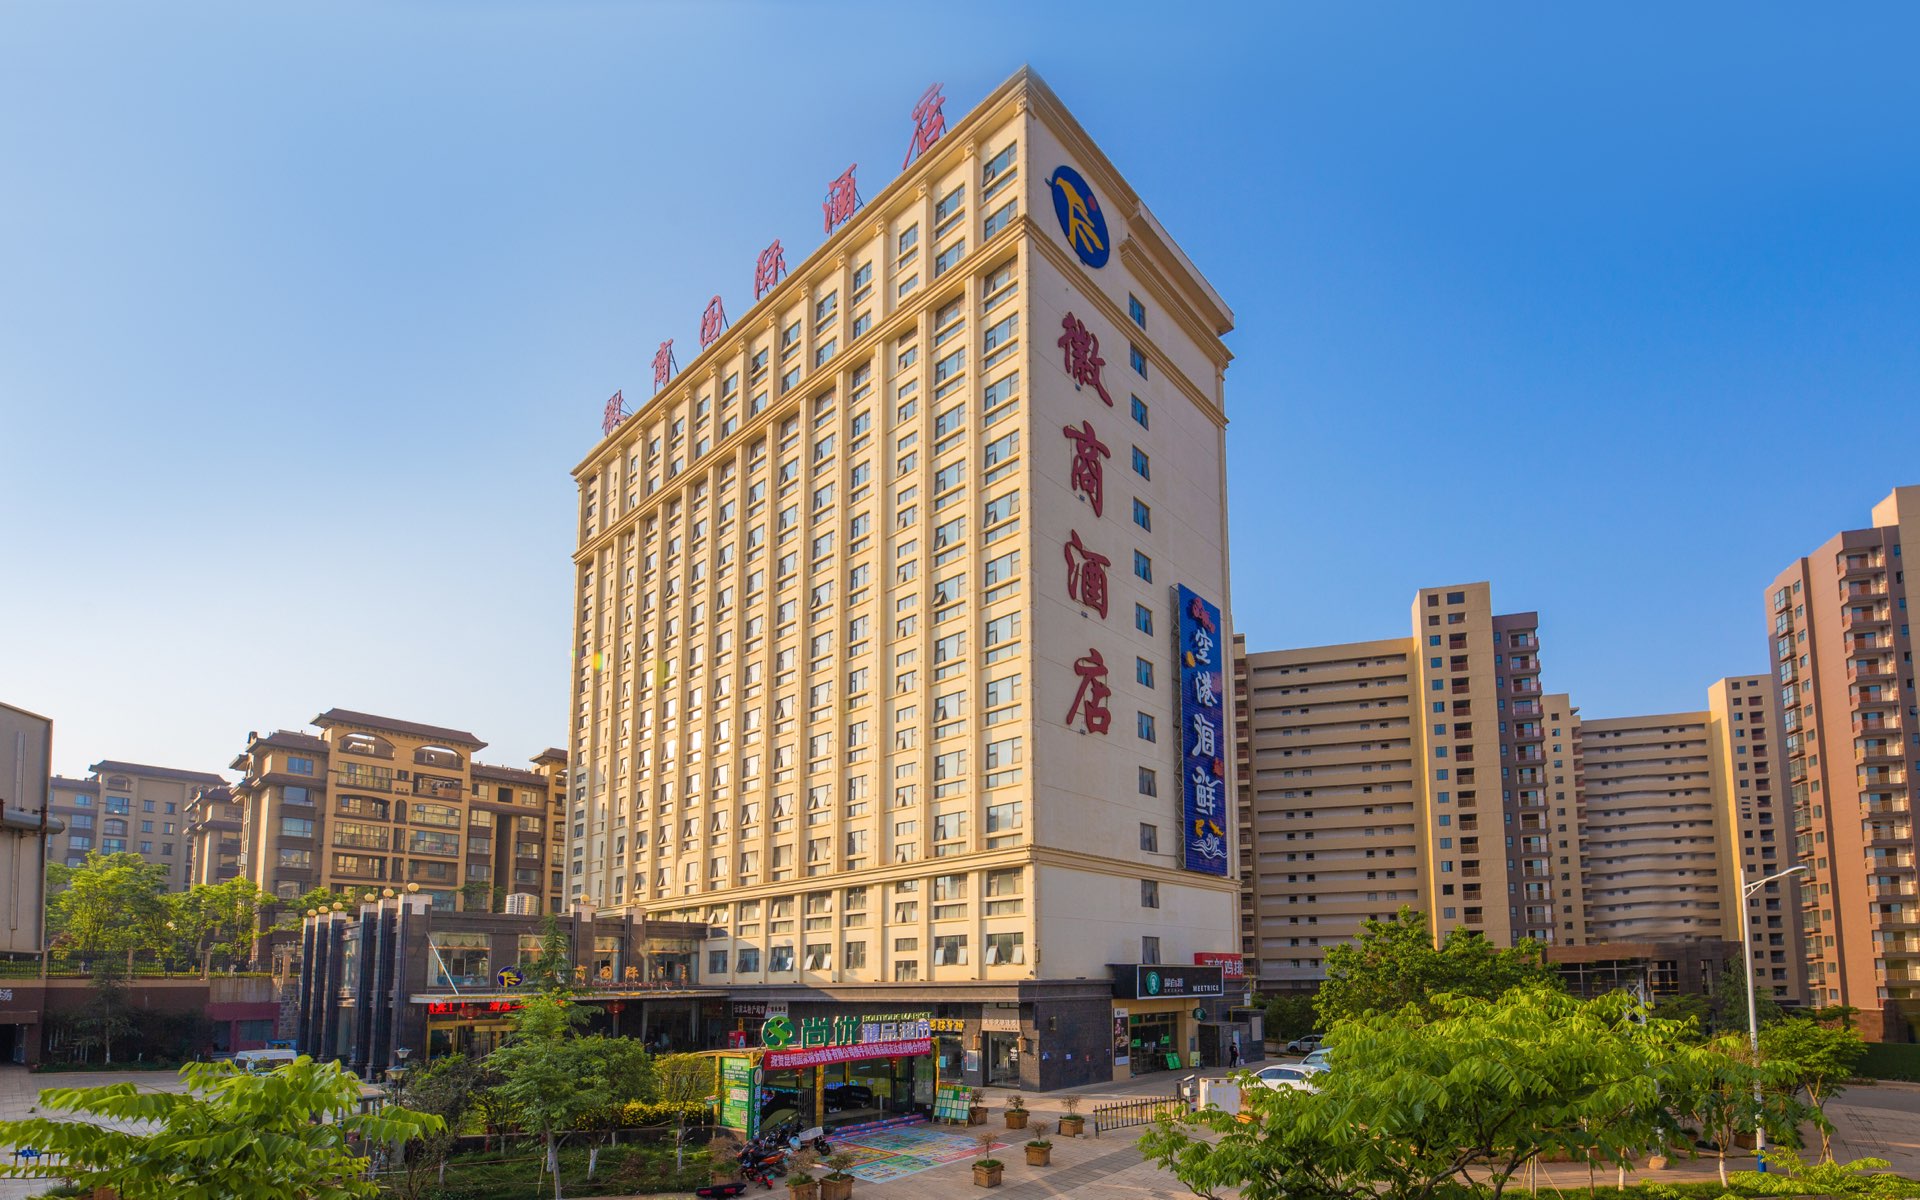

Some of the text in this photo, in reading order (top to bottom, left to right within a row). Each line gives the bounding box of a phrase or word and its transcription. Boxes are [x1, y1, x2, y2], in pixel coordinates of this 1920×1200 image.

[1058, 311, 1114, 735] 徽商酒店
[1192, 627, 1223, 816] 空港海鲜
[801, 1016, 862, 1048] 尚优
[862, 1019, 931, 1044] 精品超市
[901, 1012, 932, 1020] MARKET
